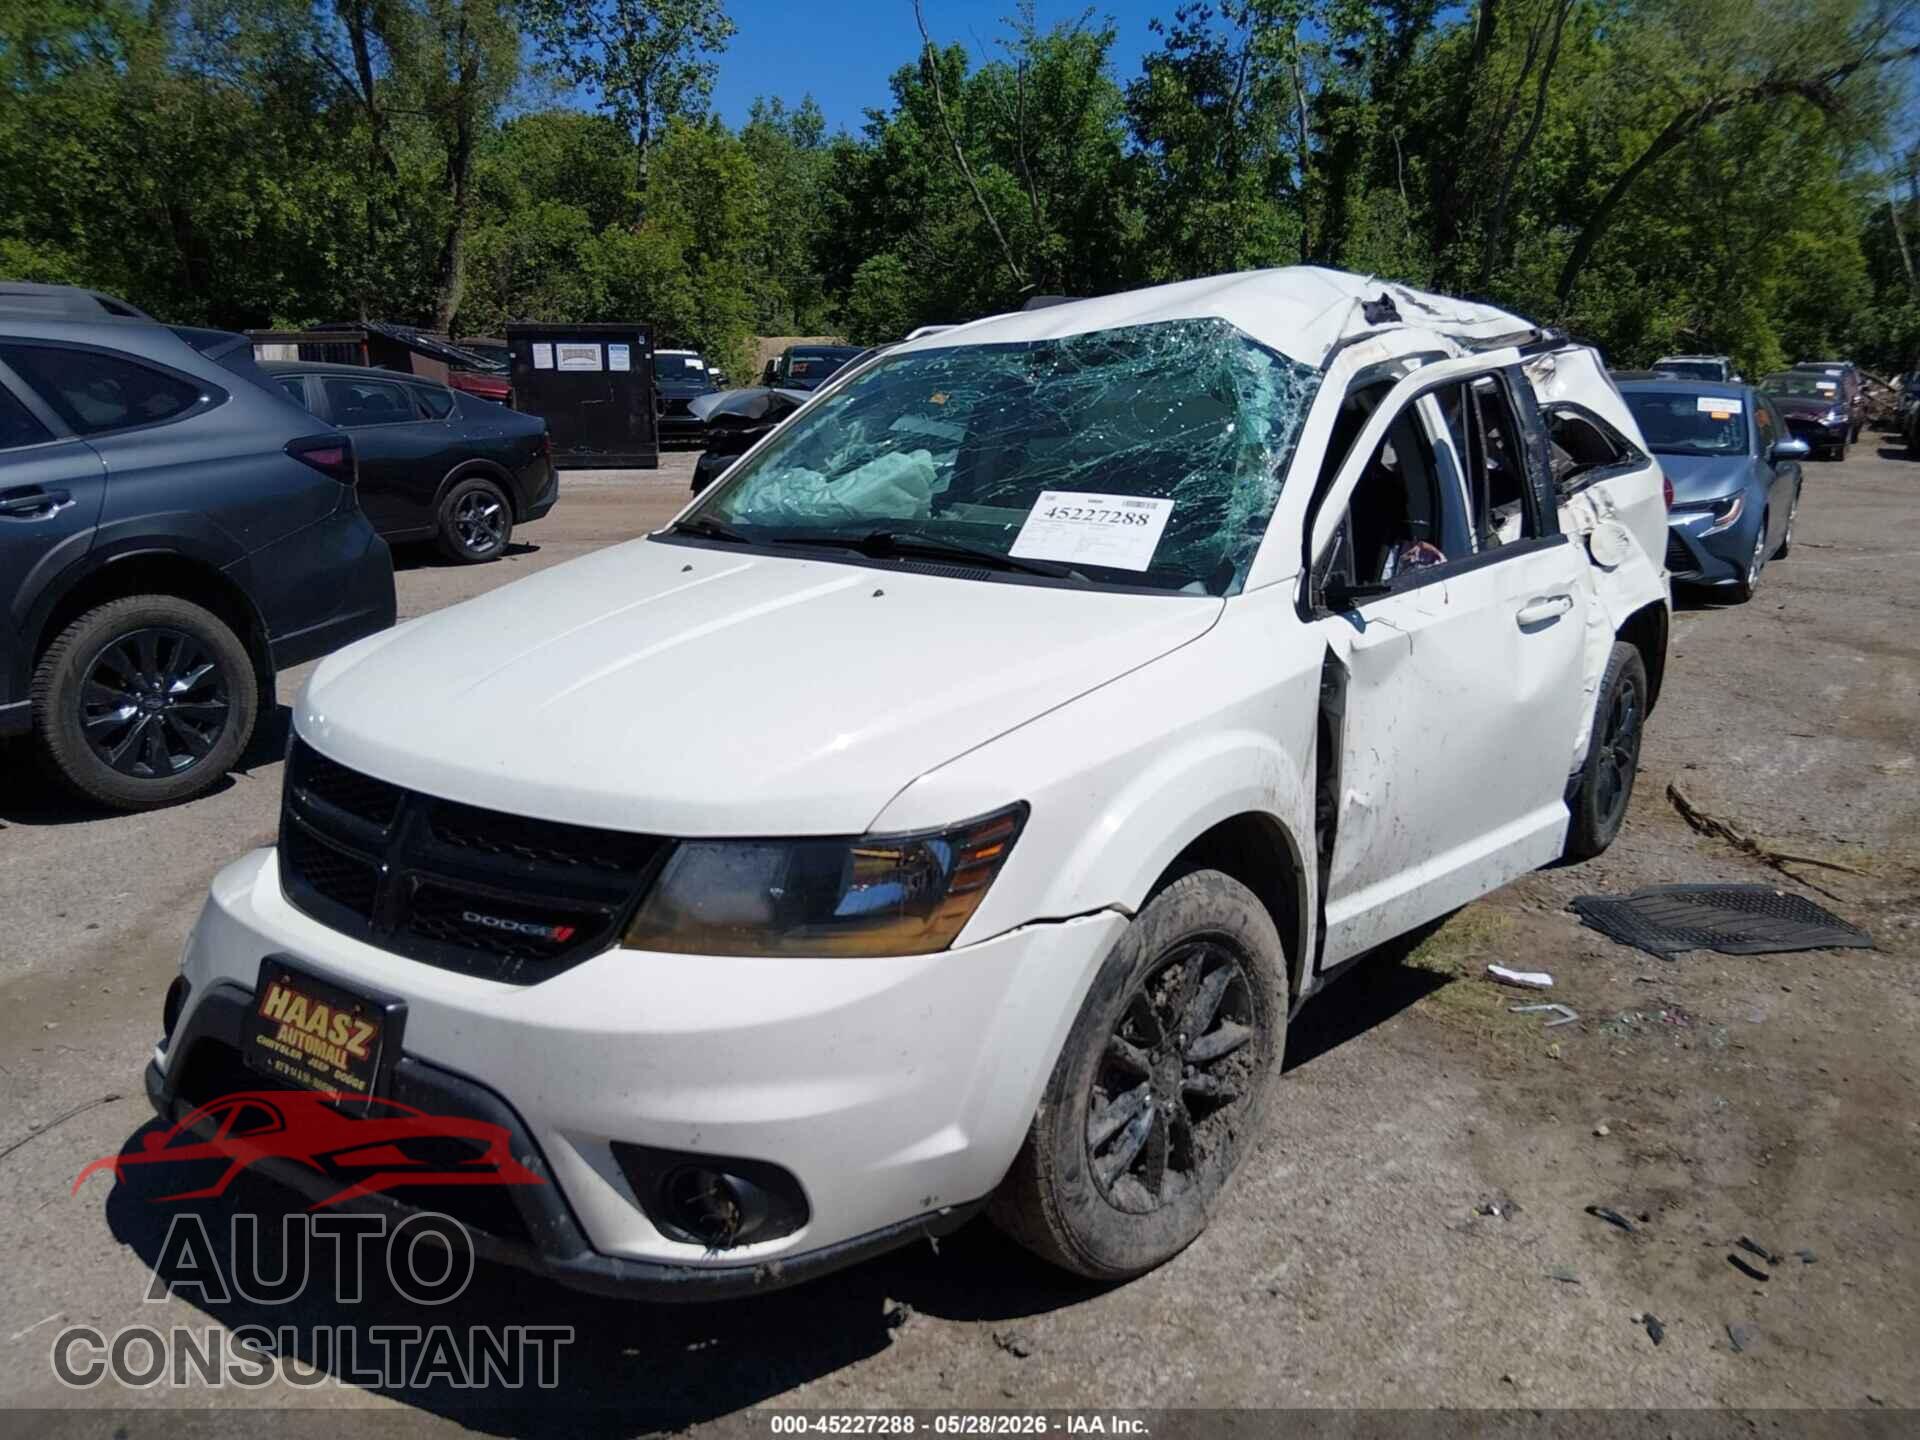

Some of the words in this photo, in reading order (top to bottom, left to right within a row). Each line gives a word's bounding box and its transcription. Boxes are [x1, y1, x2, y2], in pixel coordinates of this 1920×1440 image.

[1042, 506, 1151, 527] 45227288
[263, 985, 374, 1057] HAASZ
[277, 1023, 348, 1071] AUTOMALL
